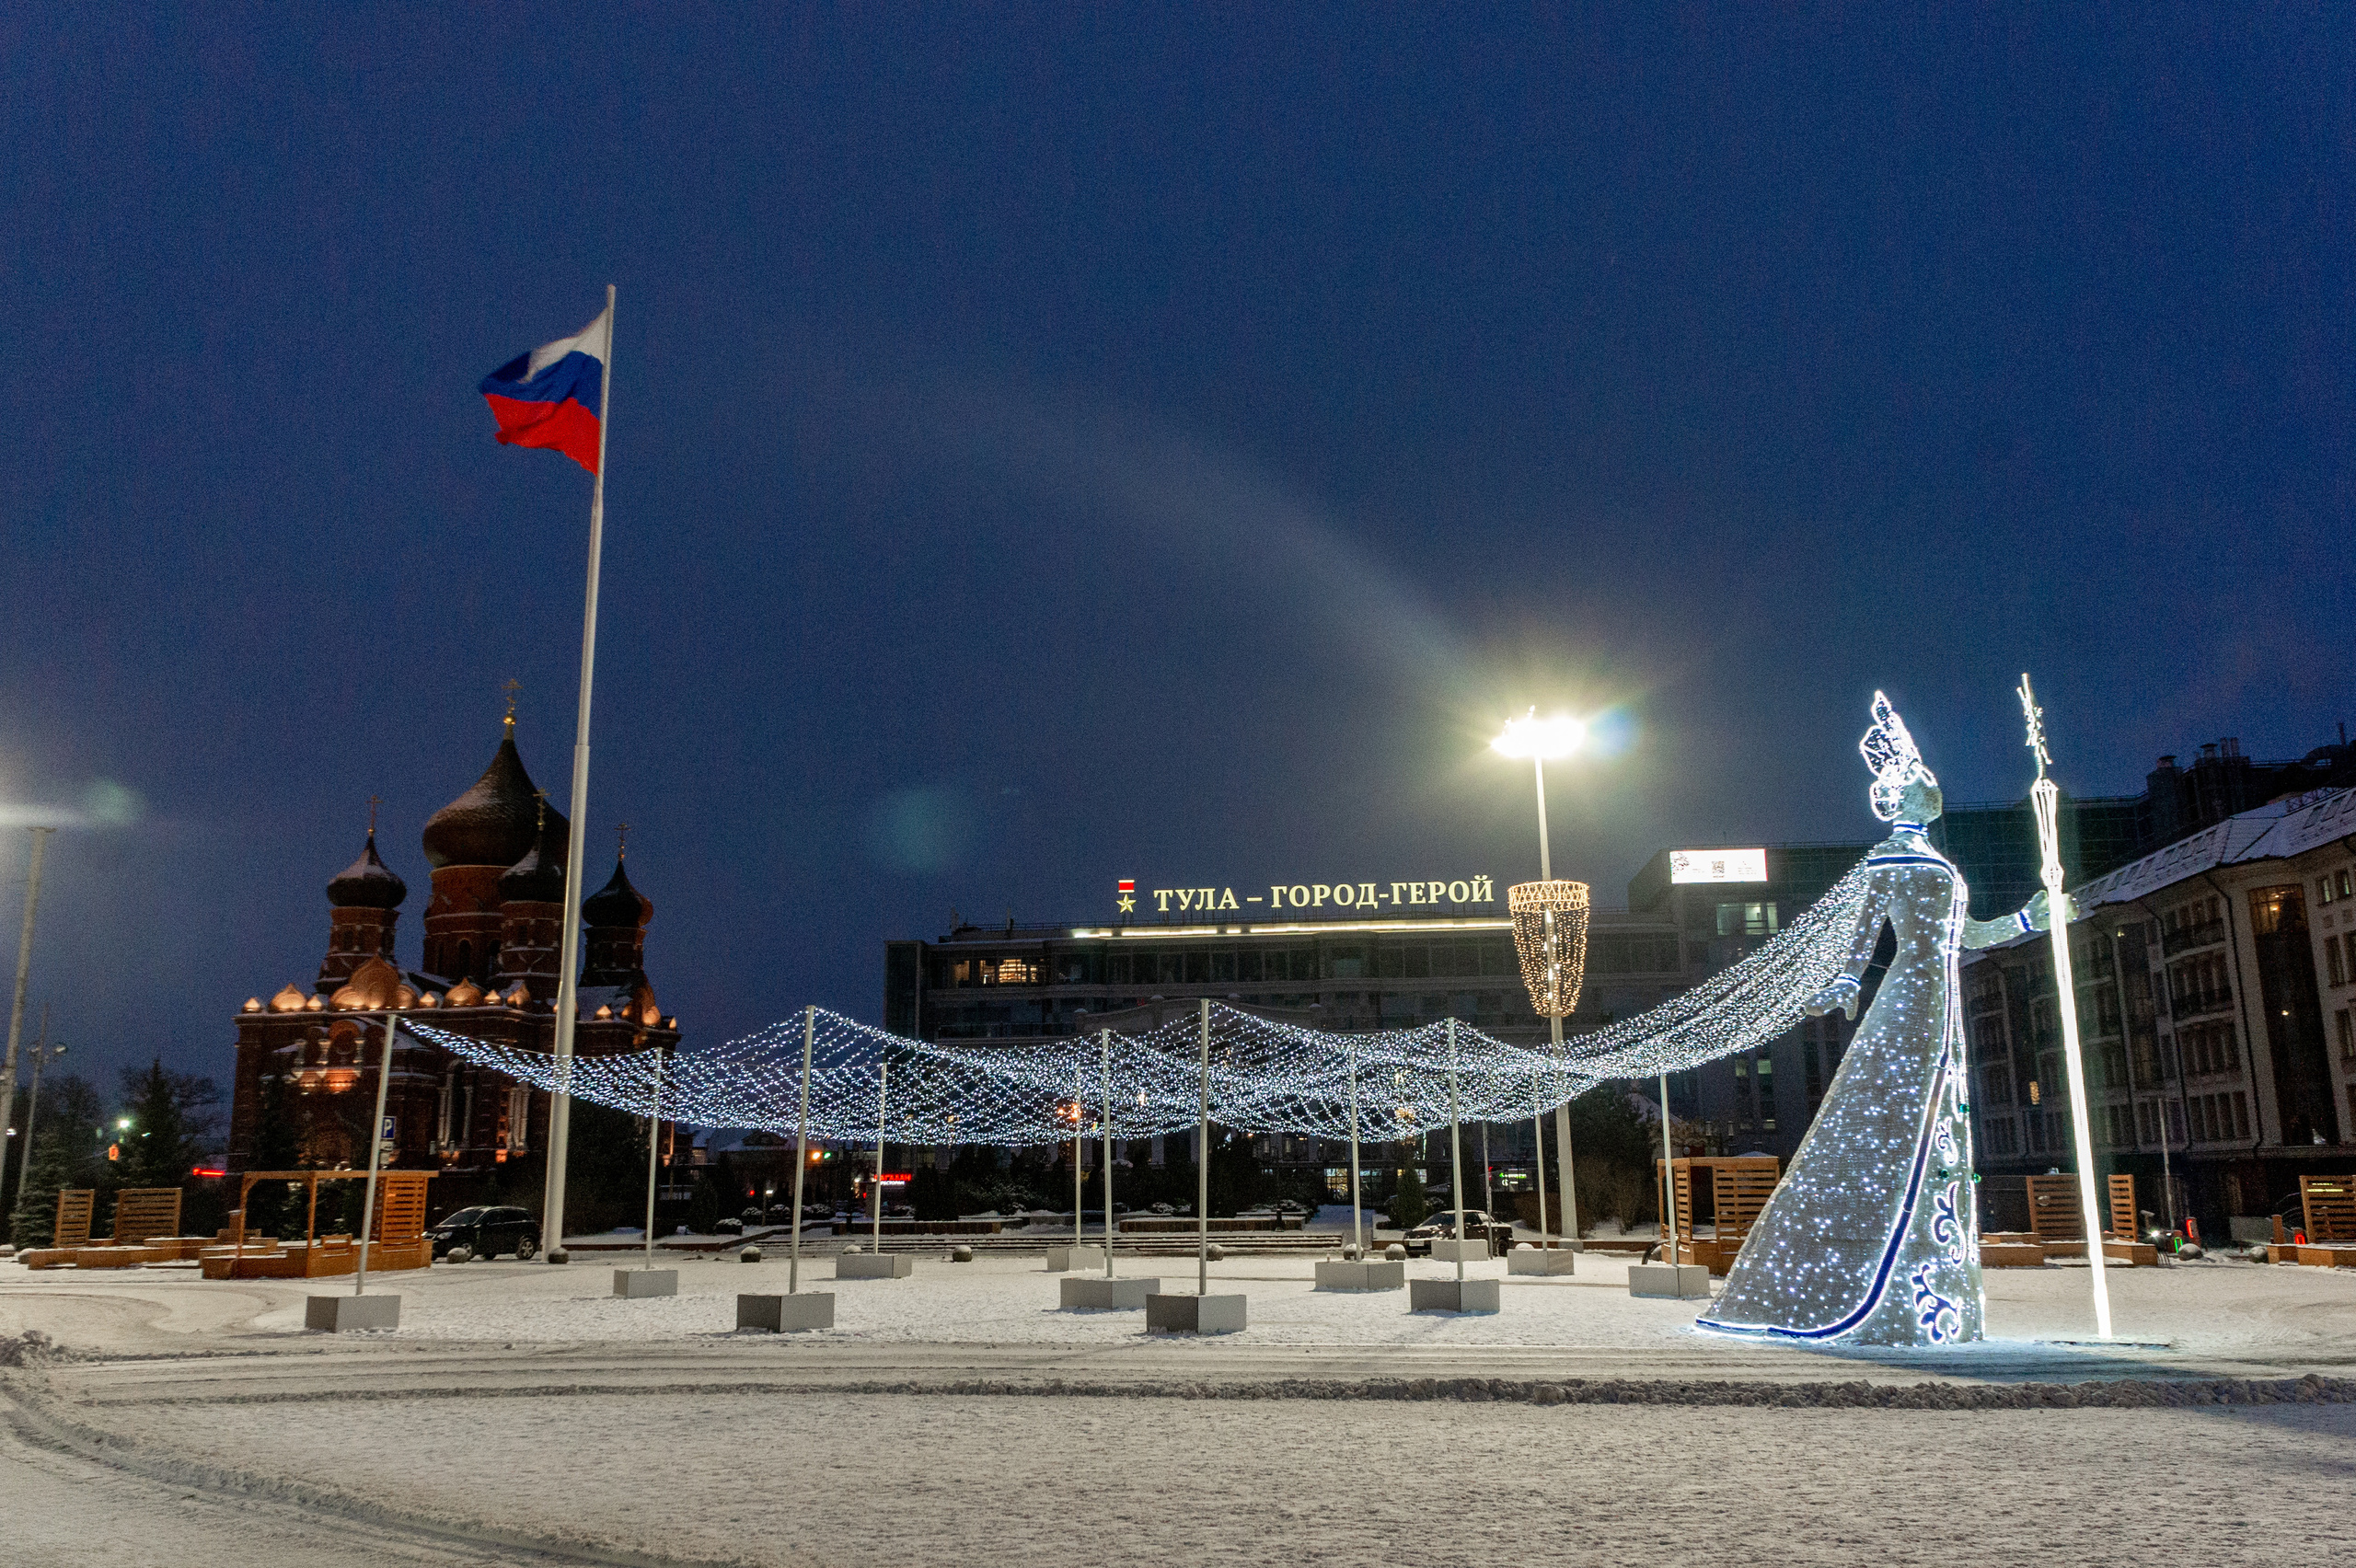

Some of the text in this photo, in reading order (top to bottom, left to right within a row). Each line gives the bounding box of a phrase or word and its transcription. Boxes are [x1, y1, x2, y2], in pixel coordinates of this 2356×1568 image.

[1153, 887, 1240, 911] ТУЛА
[1271, 874, 1495, 909] ГОРОД-ГЕРОЙ
[383, 1118, 393, 1136] P
